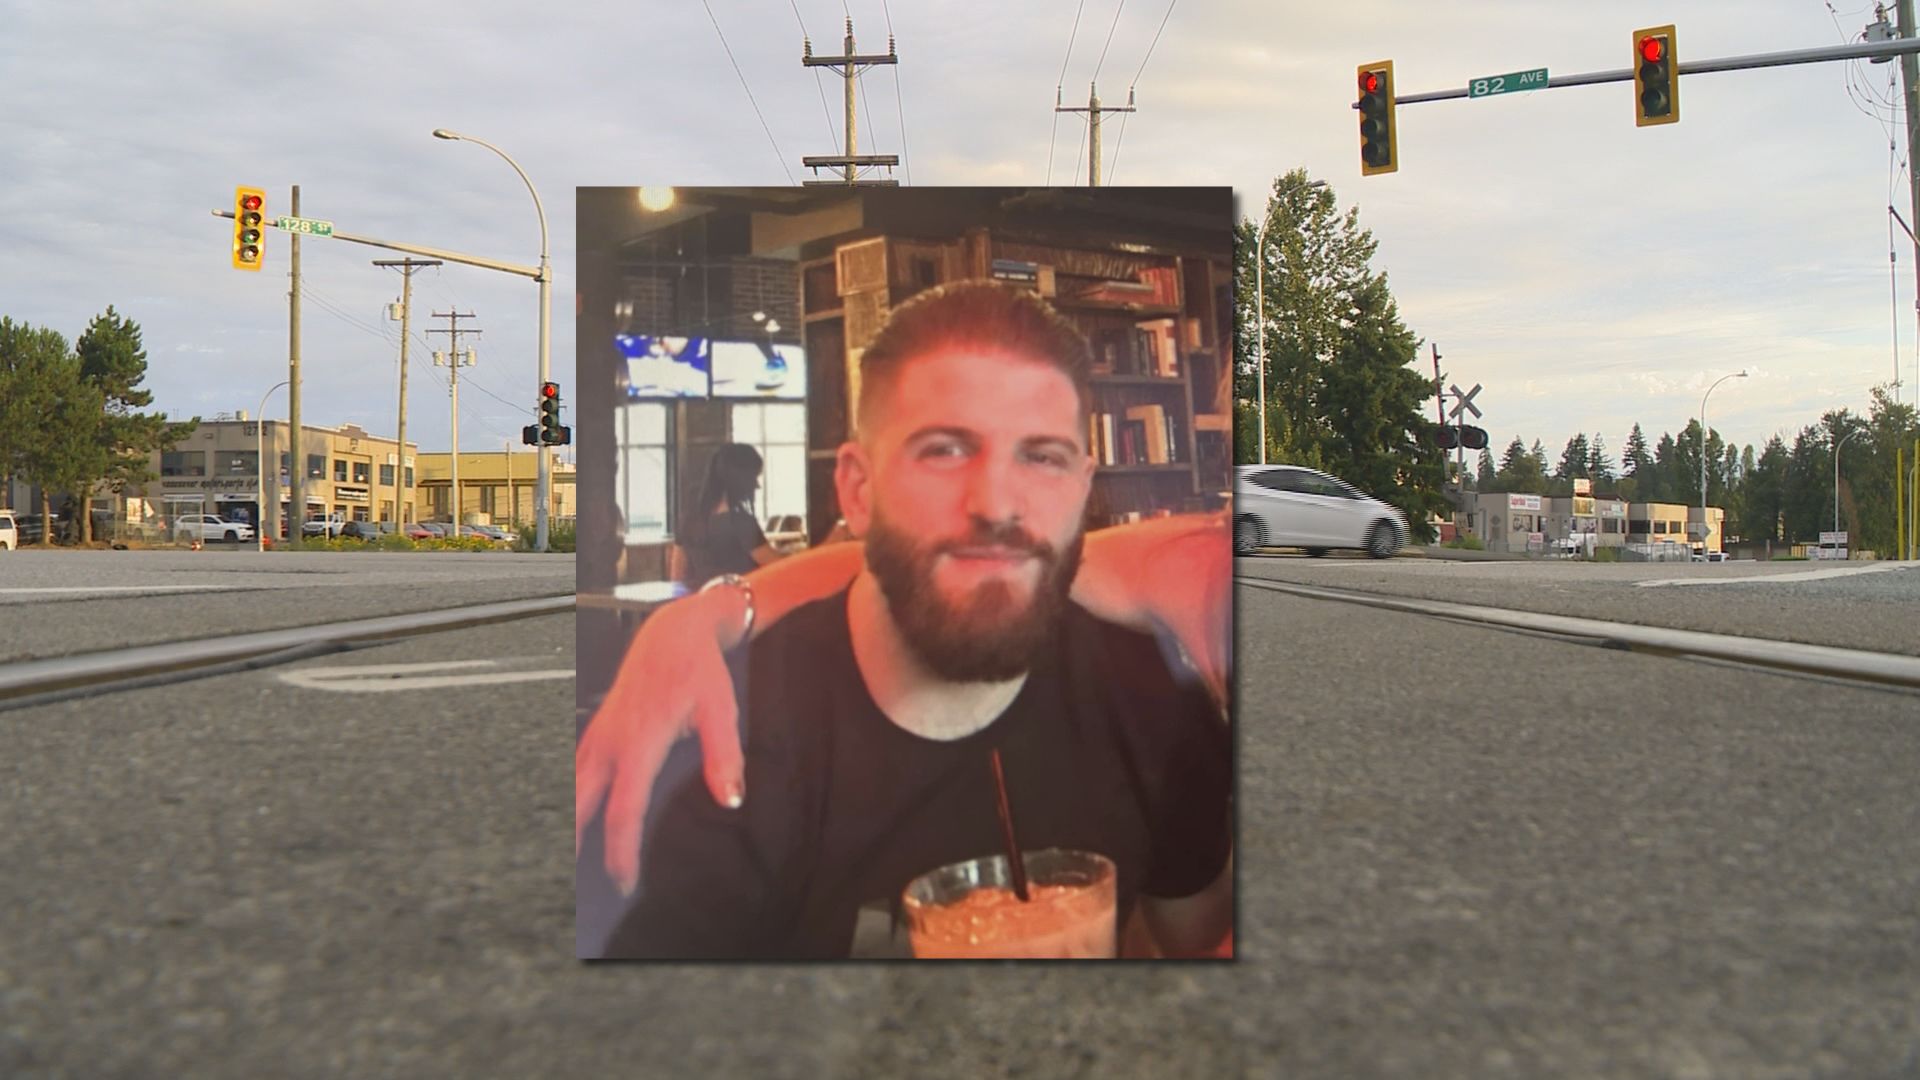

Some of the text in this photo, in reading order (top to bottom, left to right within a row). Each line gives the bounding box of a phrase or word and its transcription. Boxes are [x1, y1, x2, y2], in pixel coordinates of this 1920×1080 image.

[1474, 71, 1544, 95] 82 AVE
[283, 219, 311, 233] 128
